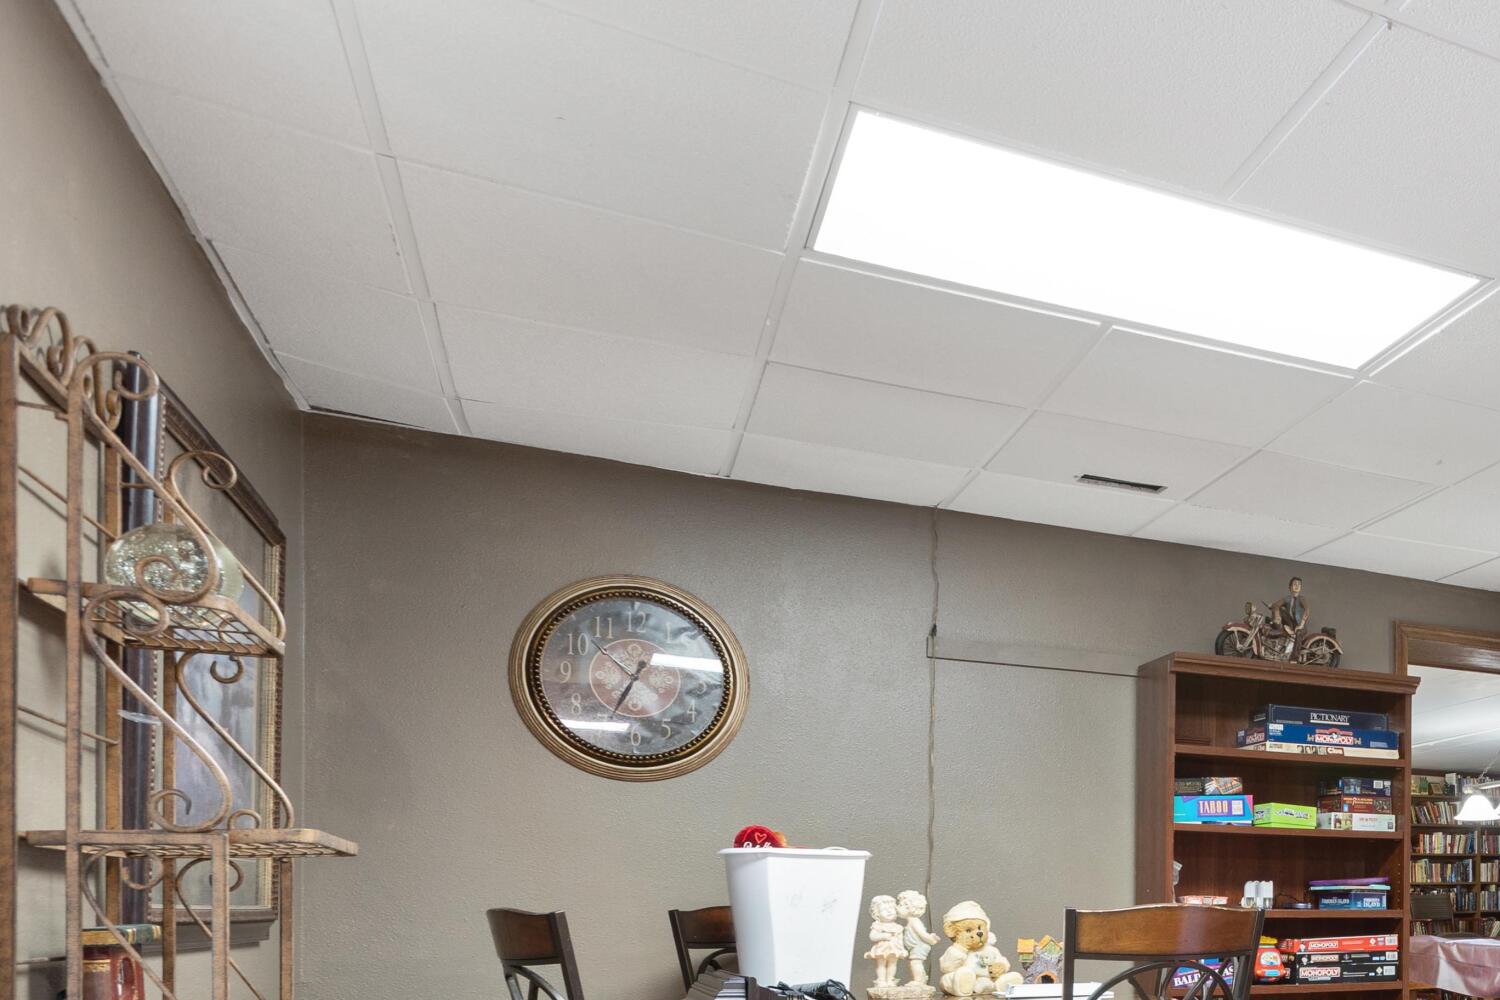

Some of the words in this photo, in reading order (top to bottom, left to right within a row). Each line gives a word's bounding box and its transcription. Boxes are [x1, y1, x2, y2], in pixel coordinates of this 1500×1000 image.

[594, 615, 613, 639] 11
[625, 610, 647, 633] 12
[567, 632, 590, 656] 10
[665, 623, 673, 643] 1
[559, 660, 572, 684] 9
[570, 692, 582, 716] 8
[686, 700, 697, 723] 4
[1310, 712, 1349, 723] PICTIONARY
[630, 725, 642, 746] 6
[660, 718, 672, 740] 5
[1315, 734, 1353, 746] MONOPOLY
[1199, 800, 1229, 814] TABOO
[1301, 968, 1339, 977] MONOPOLY
